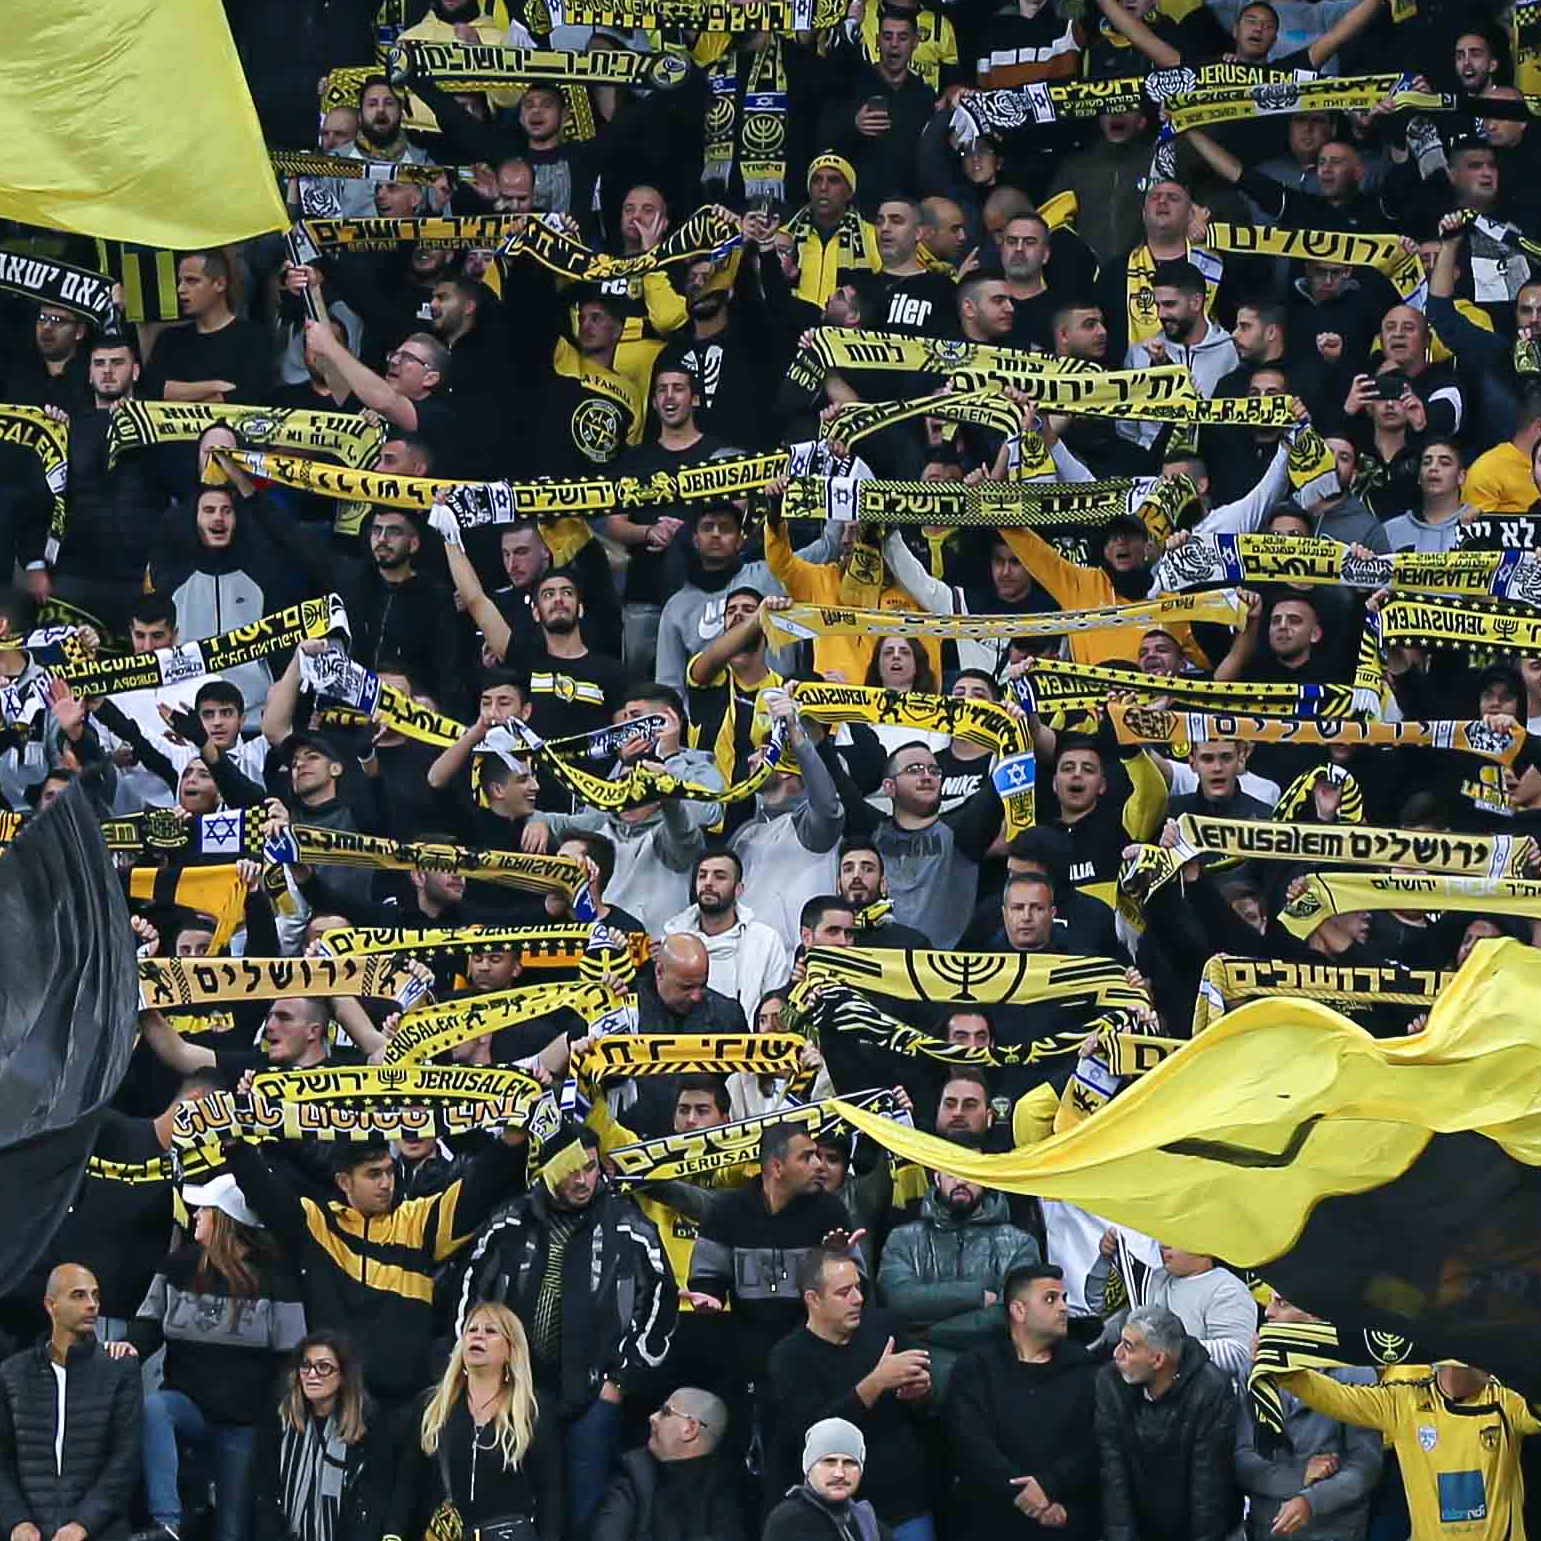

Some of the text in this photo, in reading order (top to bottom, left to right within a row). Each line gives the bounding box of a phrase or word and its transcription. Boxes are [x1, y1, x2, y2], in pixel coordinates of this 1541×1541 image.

[1196, 66, 1292, 86] JERUSALEM
[1229, 224, 1396, 258] ירושלים
[680, 460, 787, 493] JERUSALEM
[516, 481, 612, 508] ירושלים
[1500, 519, 1534, 551] לא
[1218, 720, 1429, 739] ירושלים
[941, 772, 983, 797] NIKE
[1193, 822, 1343, 856] Jerusalem
[1350, 831, 1487, 866] ירושלים
[193, 959, 358, 995] ירושלים
[1226, 960, 1397, 991] ירושלים
[259, 1072, 368, 1097] ירושלים
[413, 1068, 531, 1100] JERUSALEM
